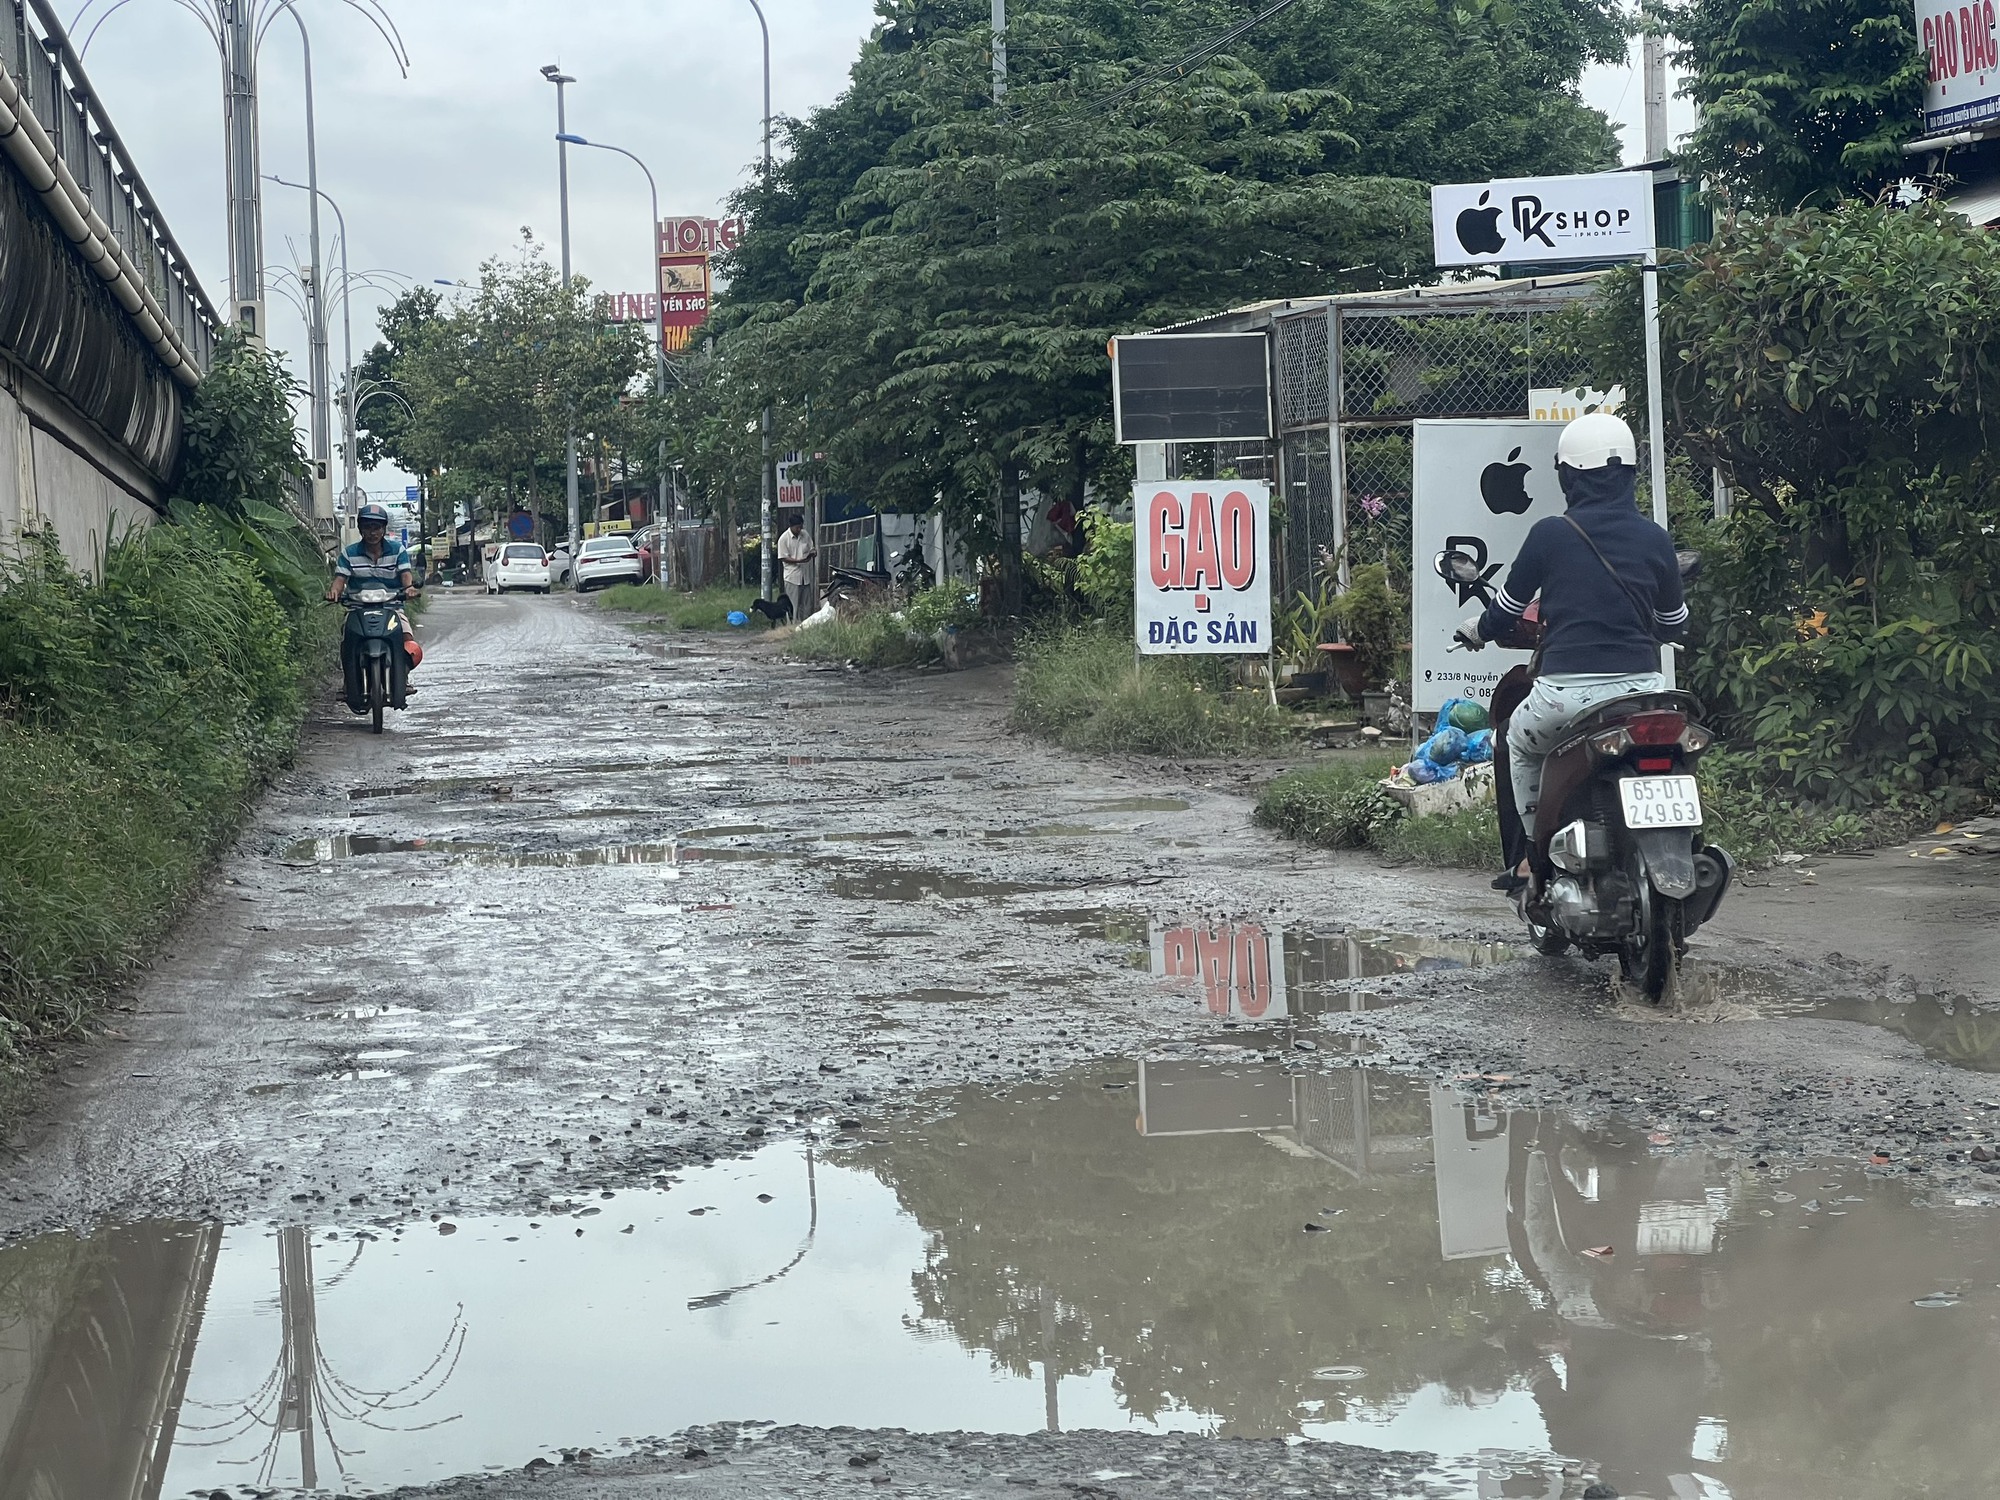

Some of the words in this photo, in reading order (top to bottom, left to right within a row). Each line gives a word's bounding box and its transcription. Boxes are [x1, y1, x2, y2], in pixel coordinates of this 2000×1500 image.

[1556, 209, 1630, 230] SHOP
[662, 295, 683, 313] YẾN
[685, 295, 706, 311] SÀO
[1149, 491, 1256, 613] GẠO
[1149, 616, 1198, 649] ĐẶC
[1207, 612, 1257, 644] SẢN
[1437, 672, 1461, 681] 233/8
[1629, 801, 1696, 825] 249.63
